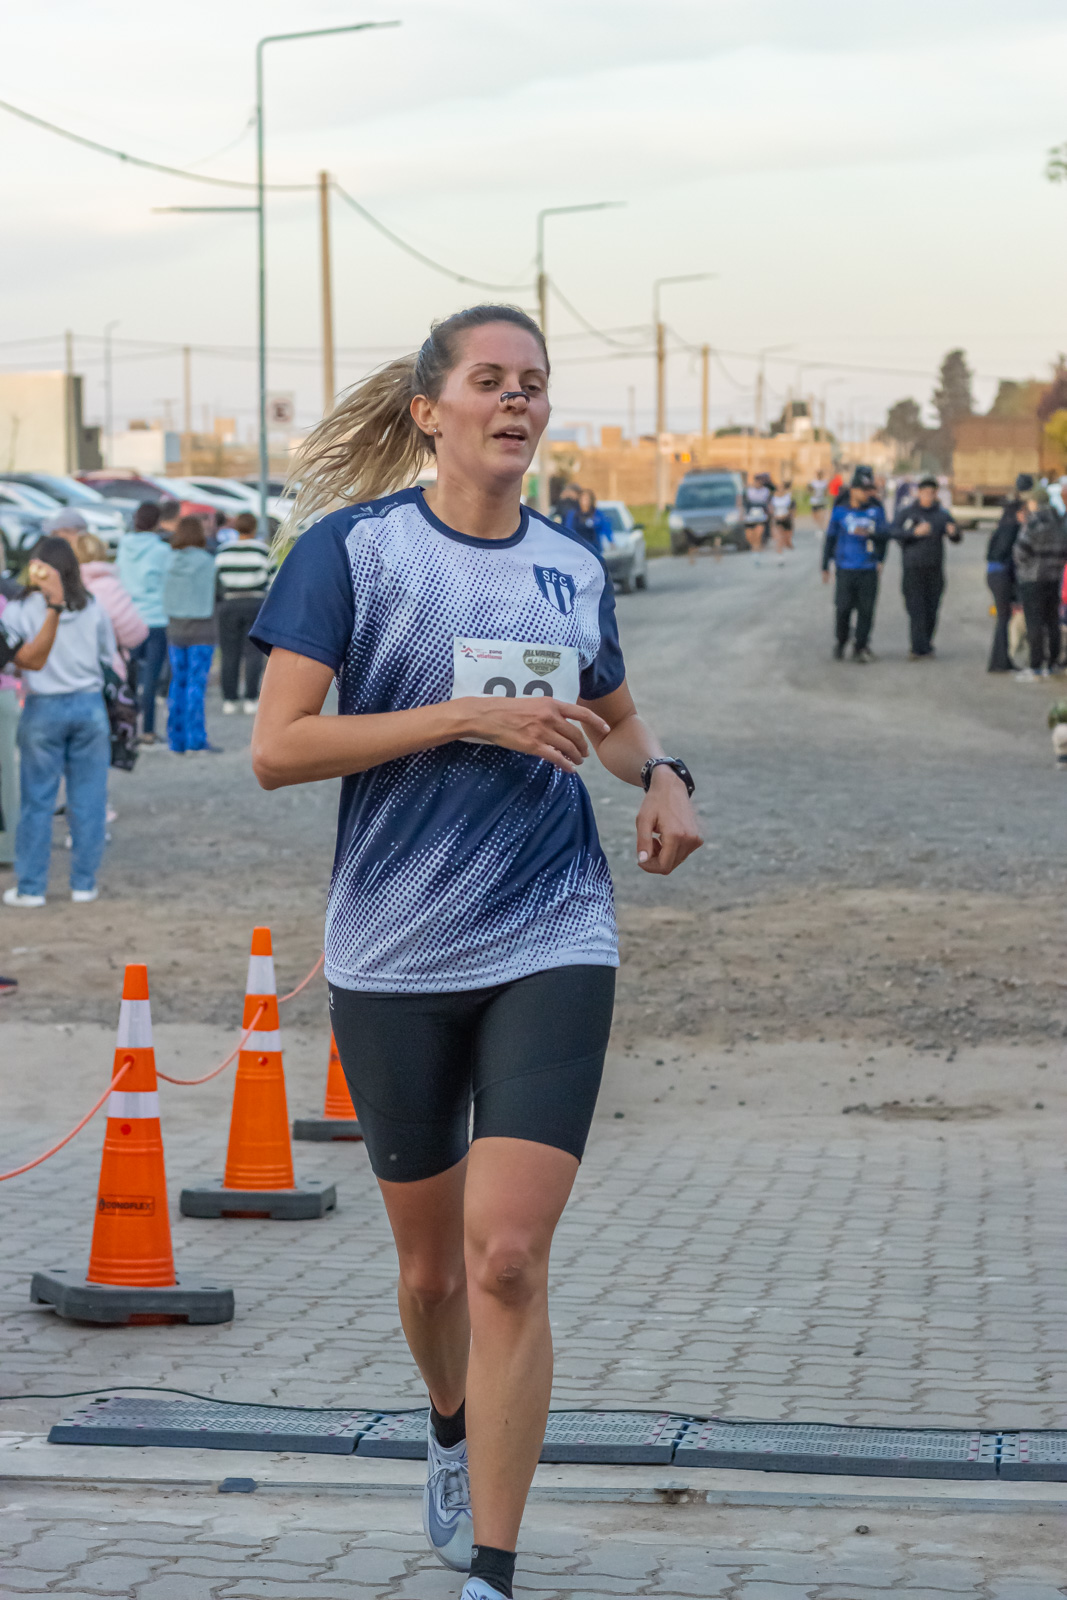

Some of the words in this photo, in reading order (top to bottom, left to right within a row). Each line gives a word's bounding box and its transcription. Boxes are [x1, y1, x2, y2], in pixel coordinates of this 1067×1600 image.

[542, 570, 568, 587] SFC
[524, 649, 561, 658] ALVAREZ
[525, 656, 560, 666] CORRE
